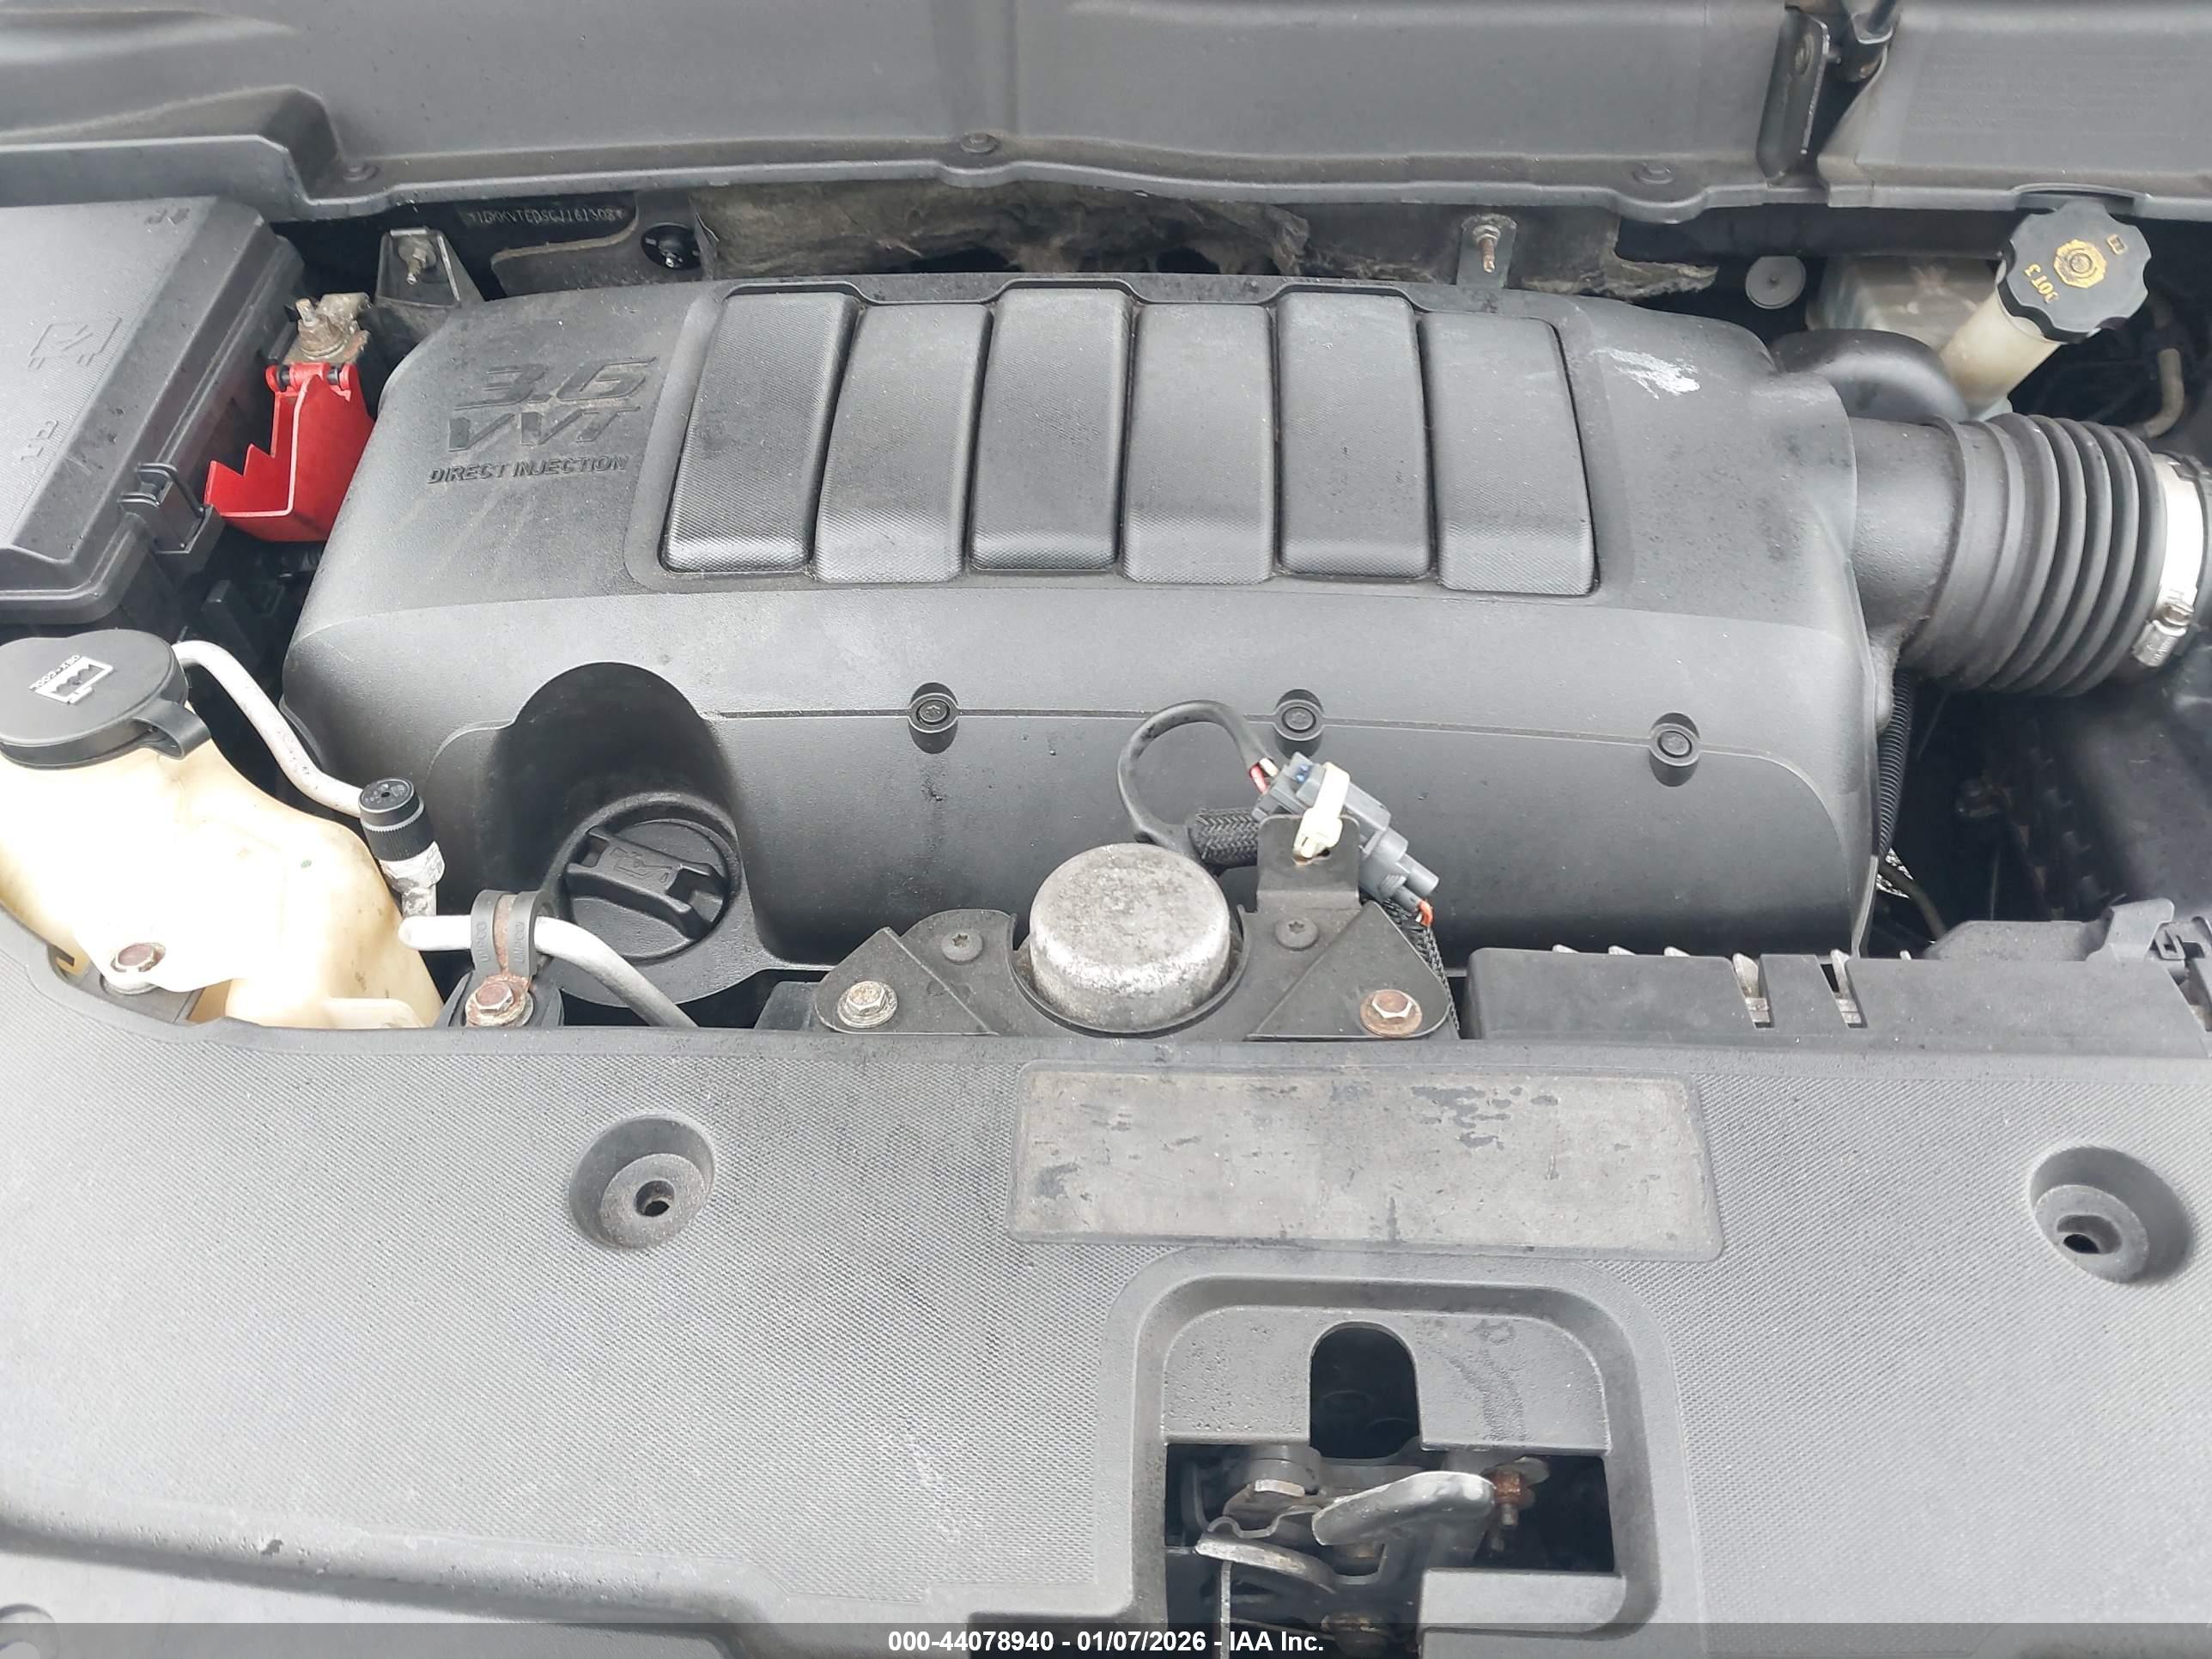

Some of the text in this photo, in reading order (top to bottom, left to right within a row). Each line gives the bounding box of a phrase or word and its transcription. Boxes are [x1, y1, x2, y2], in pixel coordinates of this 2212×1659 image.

[2024, 263, 2060, 304] DOT 3
[453, 356, 657, 410] 3.6
[448, 406, 641, 452] VVT
[428, 453, 629, 484] DIRECT INJECTION
